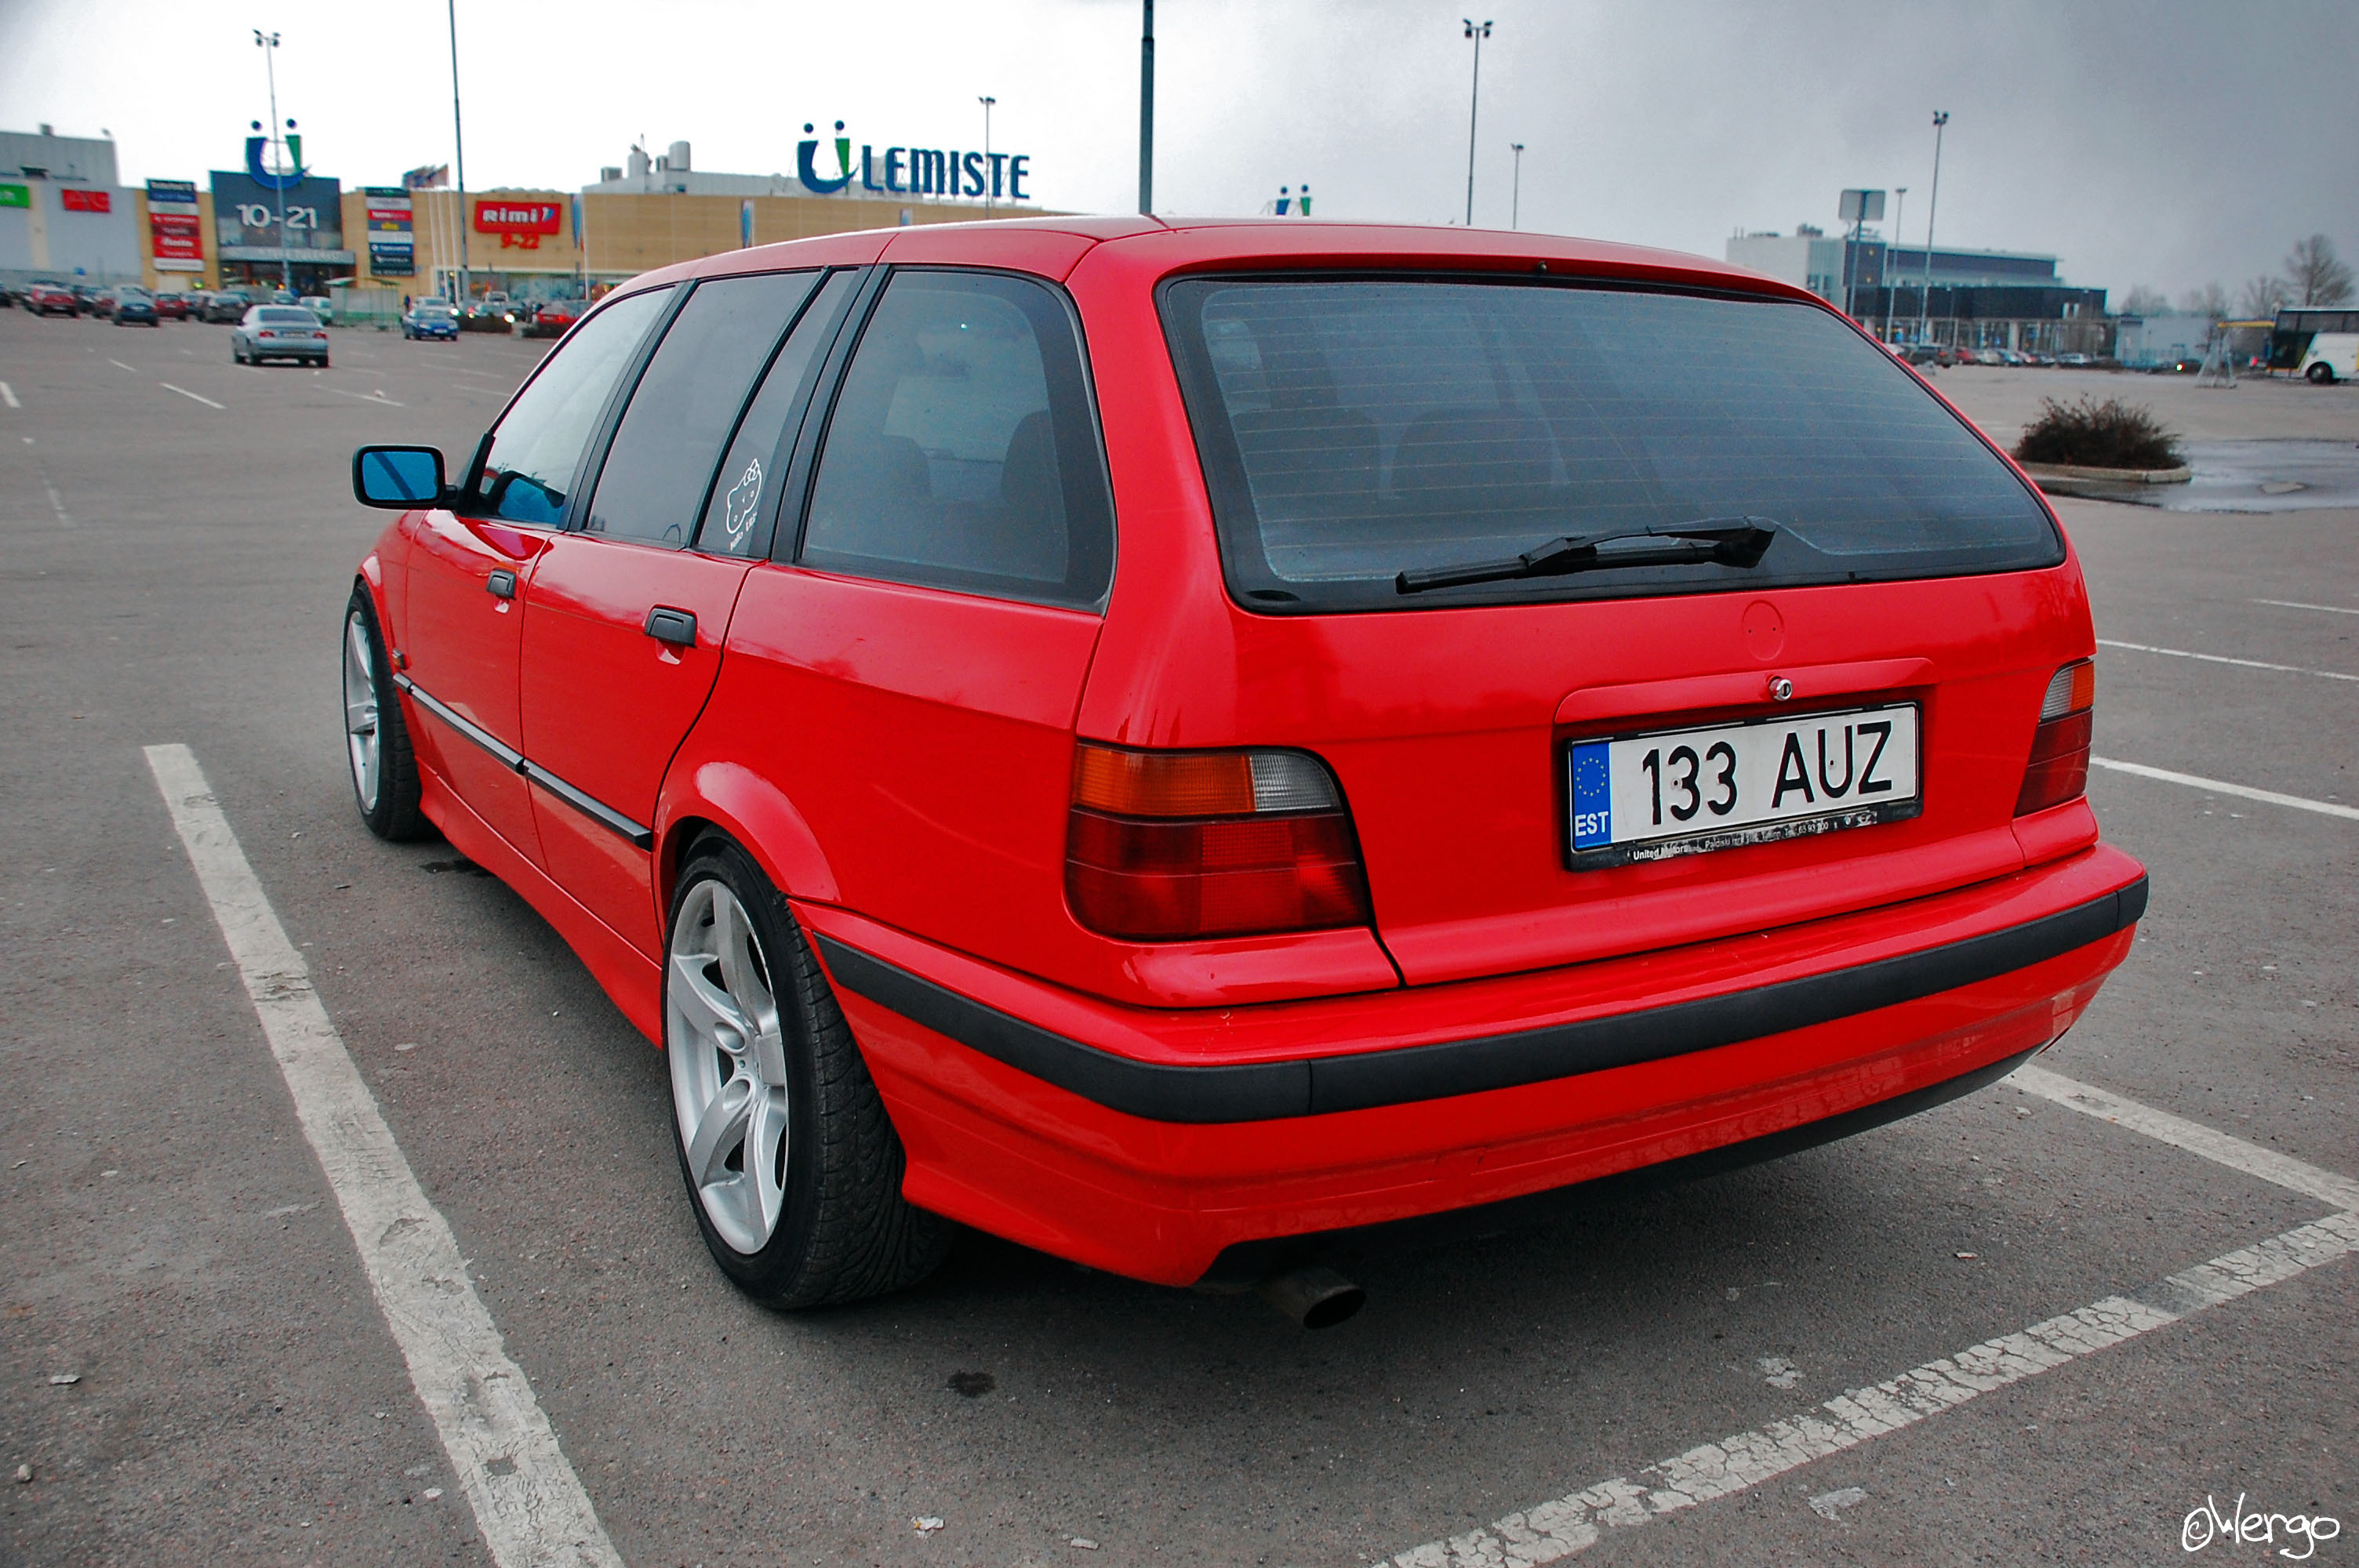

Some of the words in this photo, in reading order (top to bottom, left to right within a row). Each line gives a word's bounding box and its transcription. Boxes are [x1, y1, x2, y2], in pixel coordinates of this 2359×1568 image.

[798, 120, 1030, 199] ÜLEMISTE
[235, 204, 318, 230] 10-21
[1642, 742, 1738, 826] 133
[1772, 720, 1892, 808] AUZ
[1576, 811, 1609, 837] EST
[1634, 848, 1659, 861] United
